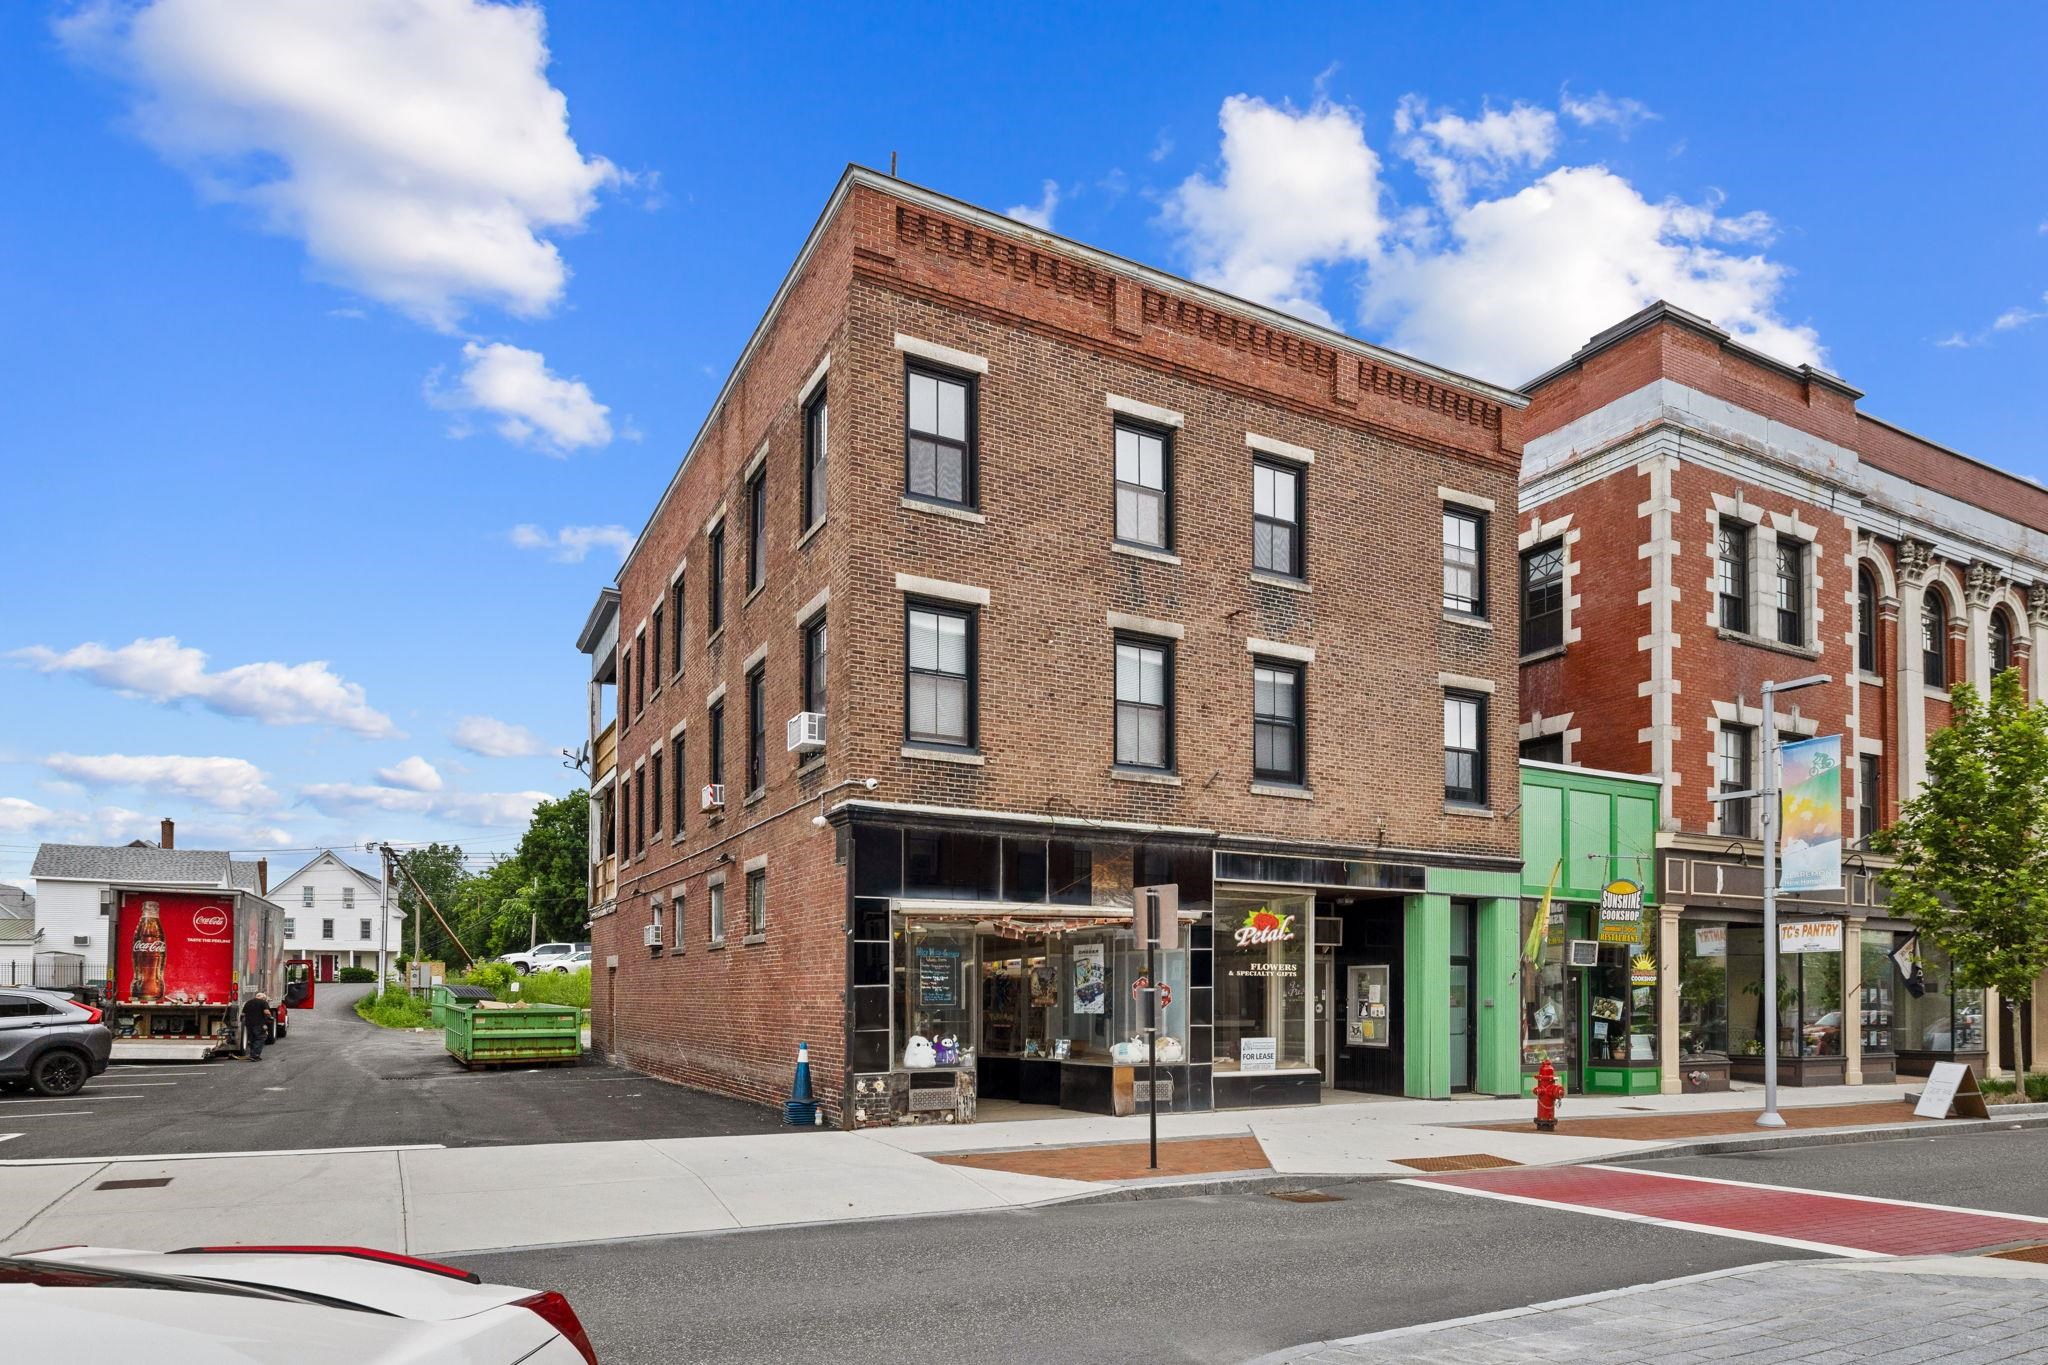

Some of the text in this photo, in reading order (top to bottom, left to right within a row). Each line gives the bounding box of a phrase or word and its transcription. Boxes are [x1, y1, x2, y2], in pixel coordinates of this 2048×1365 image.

[1602, 889, 1641, 909] SUNSHINE
[195, 915, 225, 925] Coca-Cola
[1601, 909, 1640, 921] COOKSHOP
[1782, 922, 1839, 940] TC's PANTRY
[1600, 932, 1639, 943] RESTAURANT
[1250, 963, 1297, 971] FLOWERS
[1242, 1052, 1275, 1061] FOR LEASE
